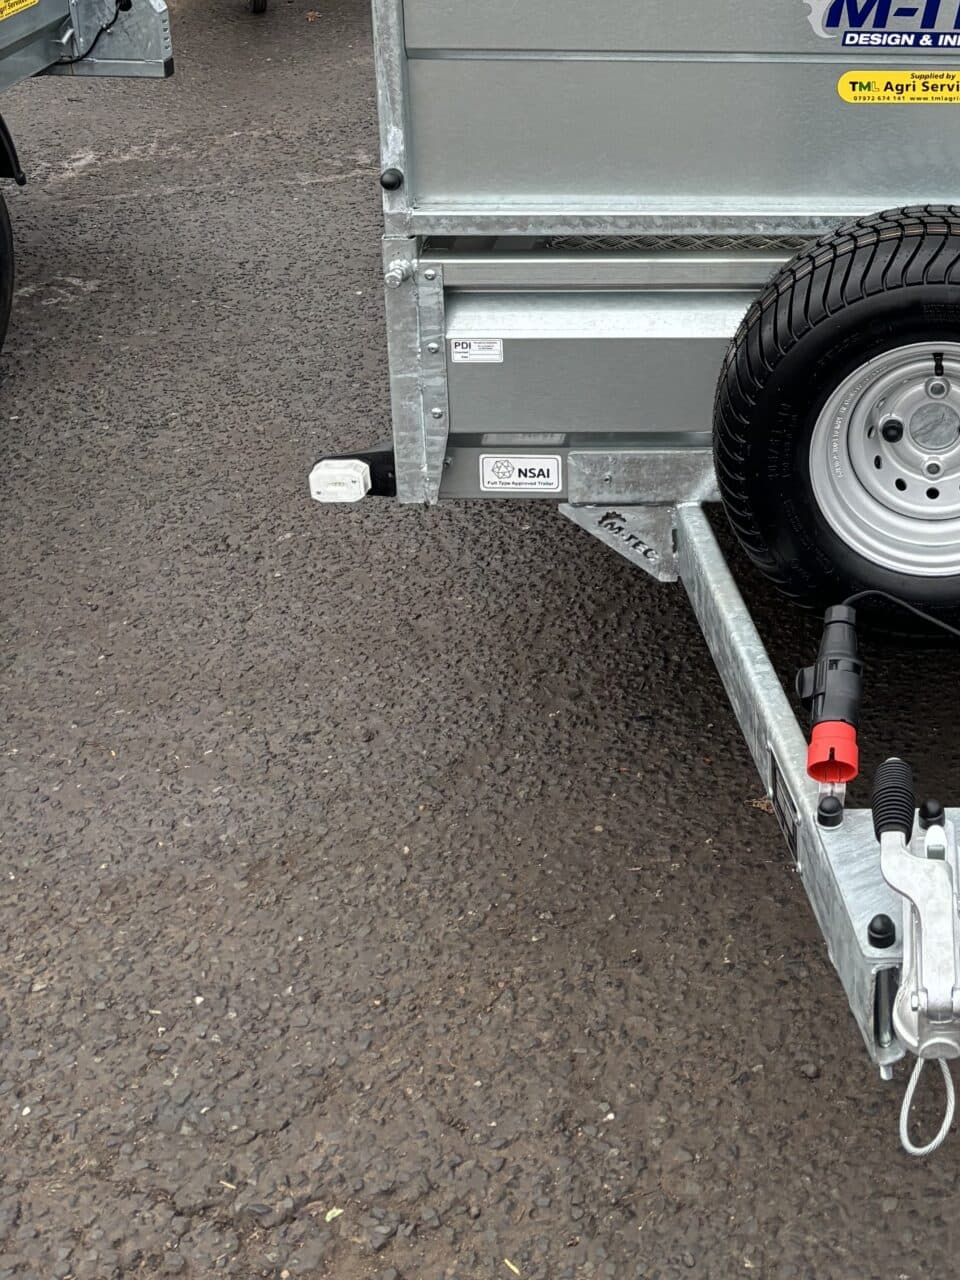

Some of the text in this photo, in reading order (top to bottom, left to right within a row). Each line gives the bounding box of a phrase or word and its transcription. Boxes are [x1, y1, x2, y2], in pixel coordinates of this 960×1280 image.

[844, 33, 916, 47] DESIGN
[919, 34, 933, 47] &
[910, 72, 957, 81] Supplied by
[849, 81, 880, 93] TML
[884, 81, 916, 94] Agri
[454, 341, 472, 350] PDI
[518, 467, 551, 479] NSAI
